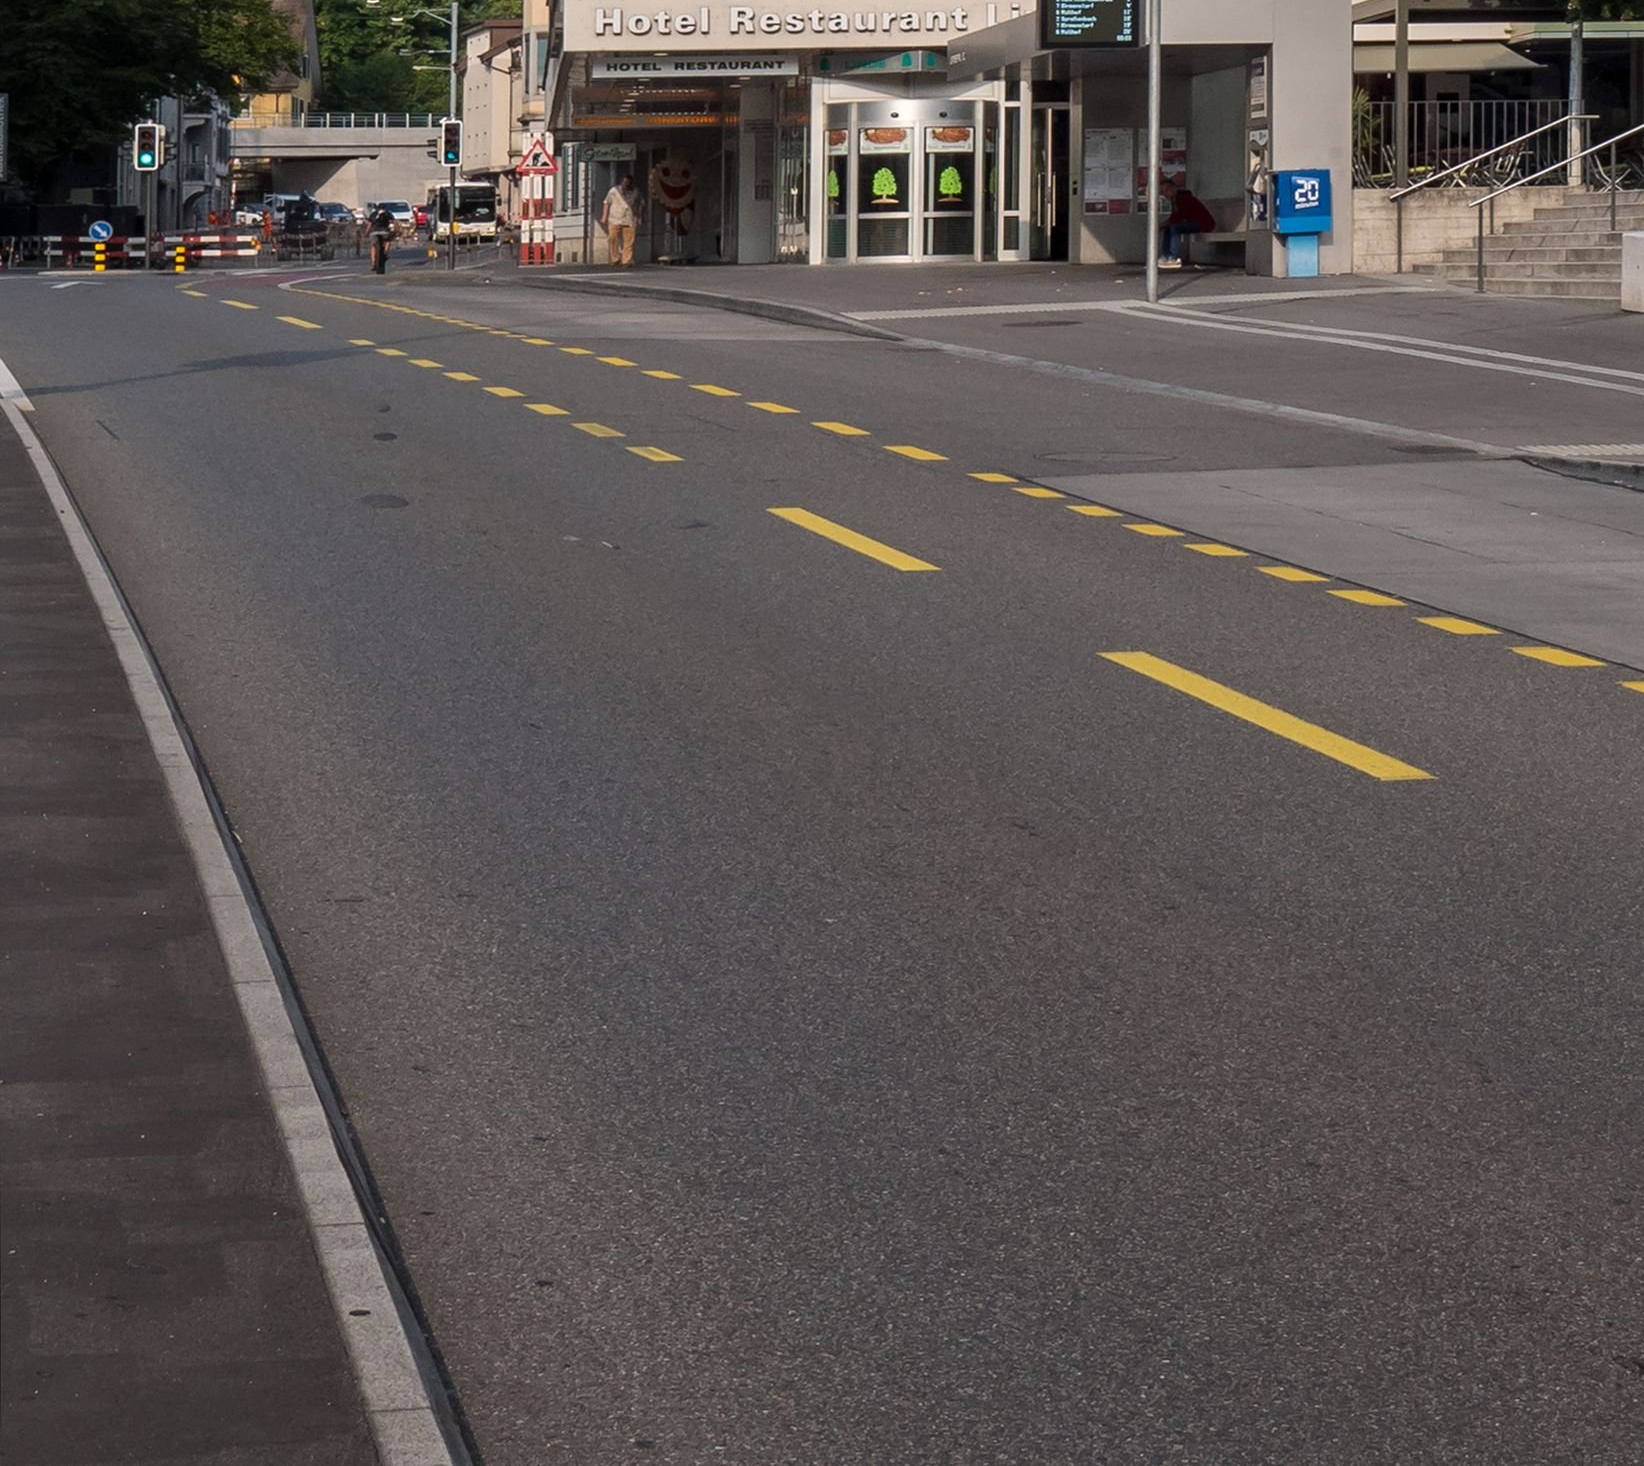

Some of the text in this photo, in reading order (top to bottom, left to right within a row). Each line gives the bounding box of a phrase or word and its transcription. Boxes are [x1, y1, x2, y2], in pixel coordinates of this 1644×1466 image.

[595, 7, 710, 36] Hotel
[729, 5, 968, 35] Restaurant
[606, 60, 785, 72] HOTEL RESTAURANT
[1294, 180, 1319, 202] 20
